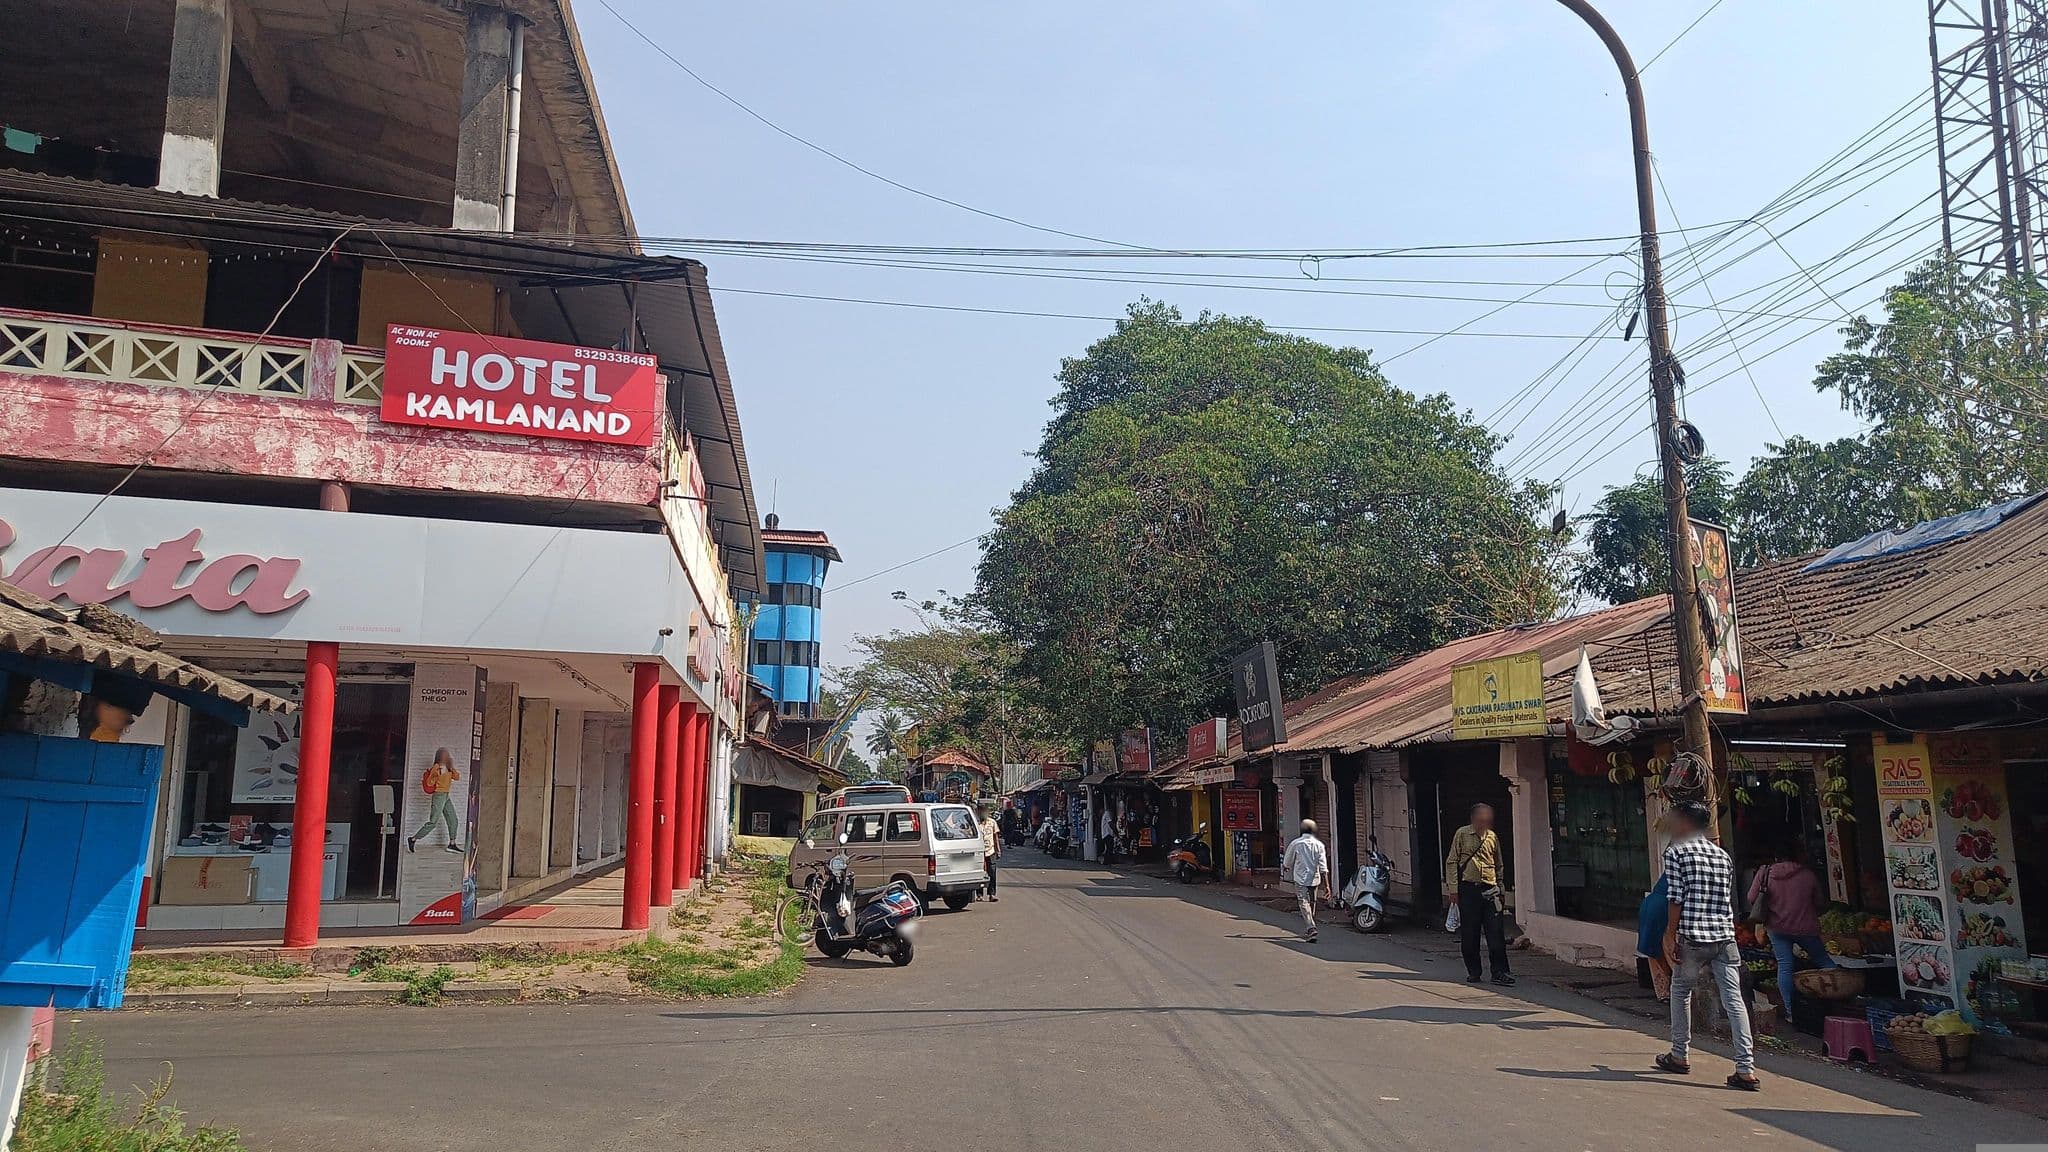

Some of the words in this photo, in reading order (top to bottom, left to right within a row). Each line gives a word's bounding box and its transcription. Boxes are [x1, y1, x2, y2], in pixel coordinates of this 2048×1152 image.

[391, 327, 404, 335] AC
[405, 328, 427, 338] NON
[427, 331, 440, 339] AC
[395, 337, 431, 348] ROOMS
[574, 348, 655, 367] 8329338463
[430, 346, 612, 403] HOTEL
[405, 392, 632, 436] KAMLANAND
[0, 517, 311, 615] ata
[1480, 715, 1497, 726] Quality
[1497, 713, 1514, 724] Fishing
[1514, 711, 1538, 721] Materials
[1882, 758, 1923, 780] RAS
[424, 909, 455, 918] Bata
